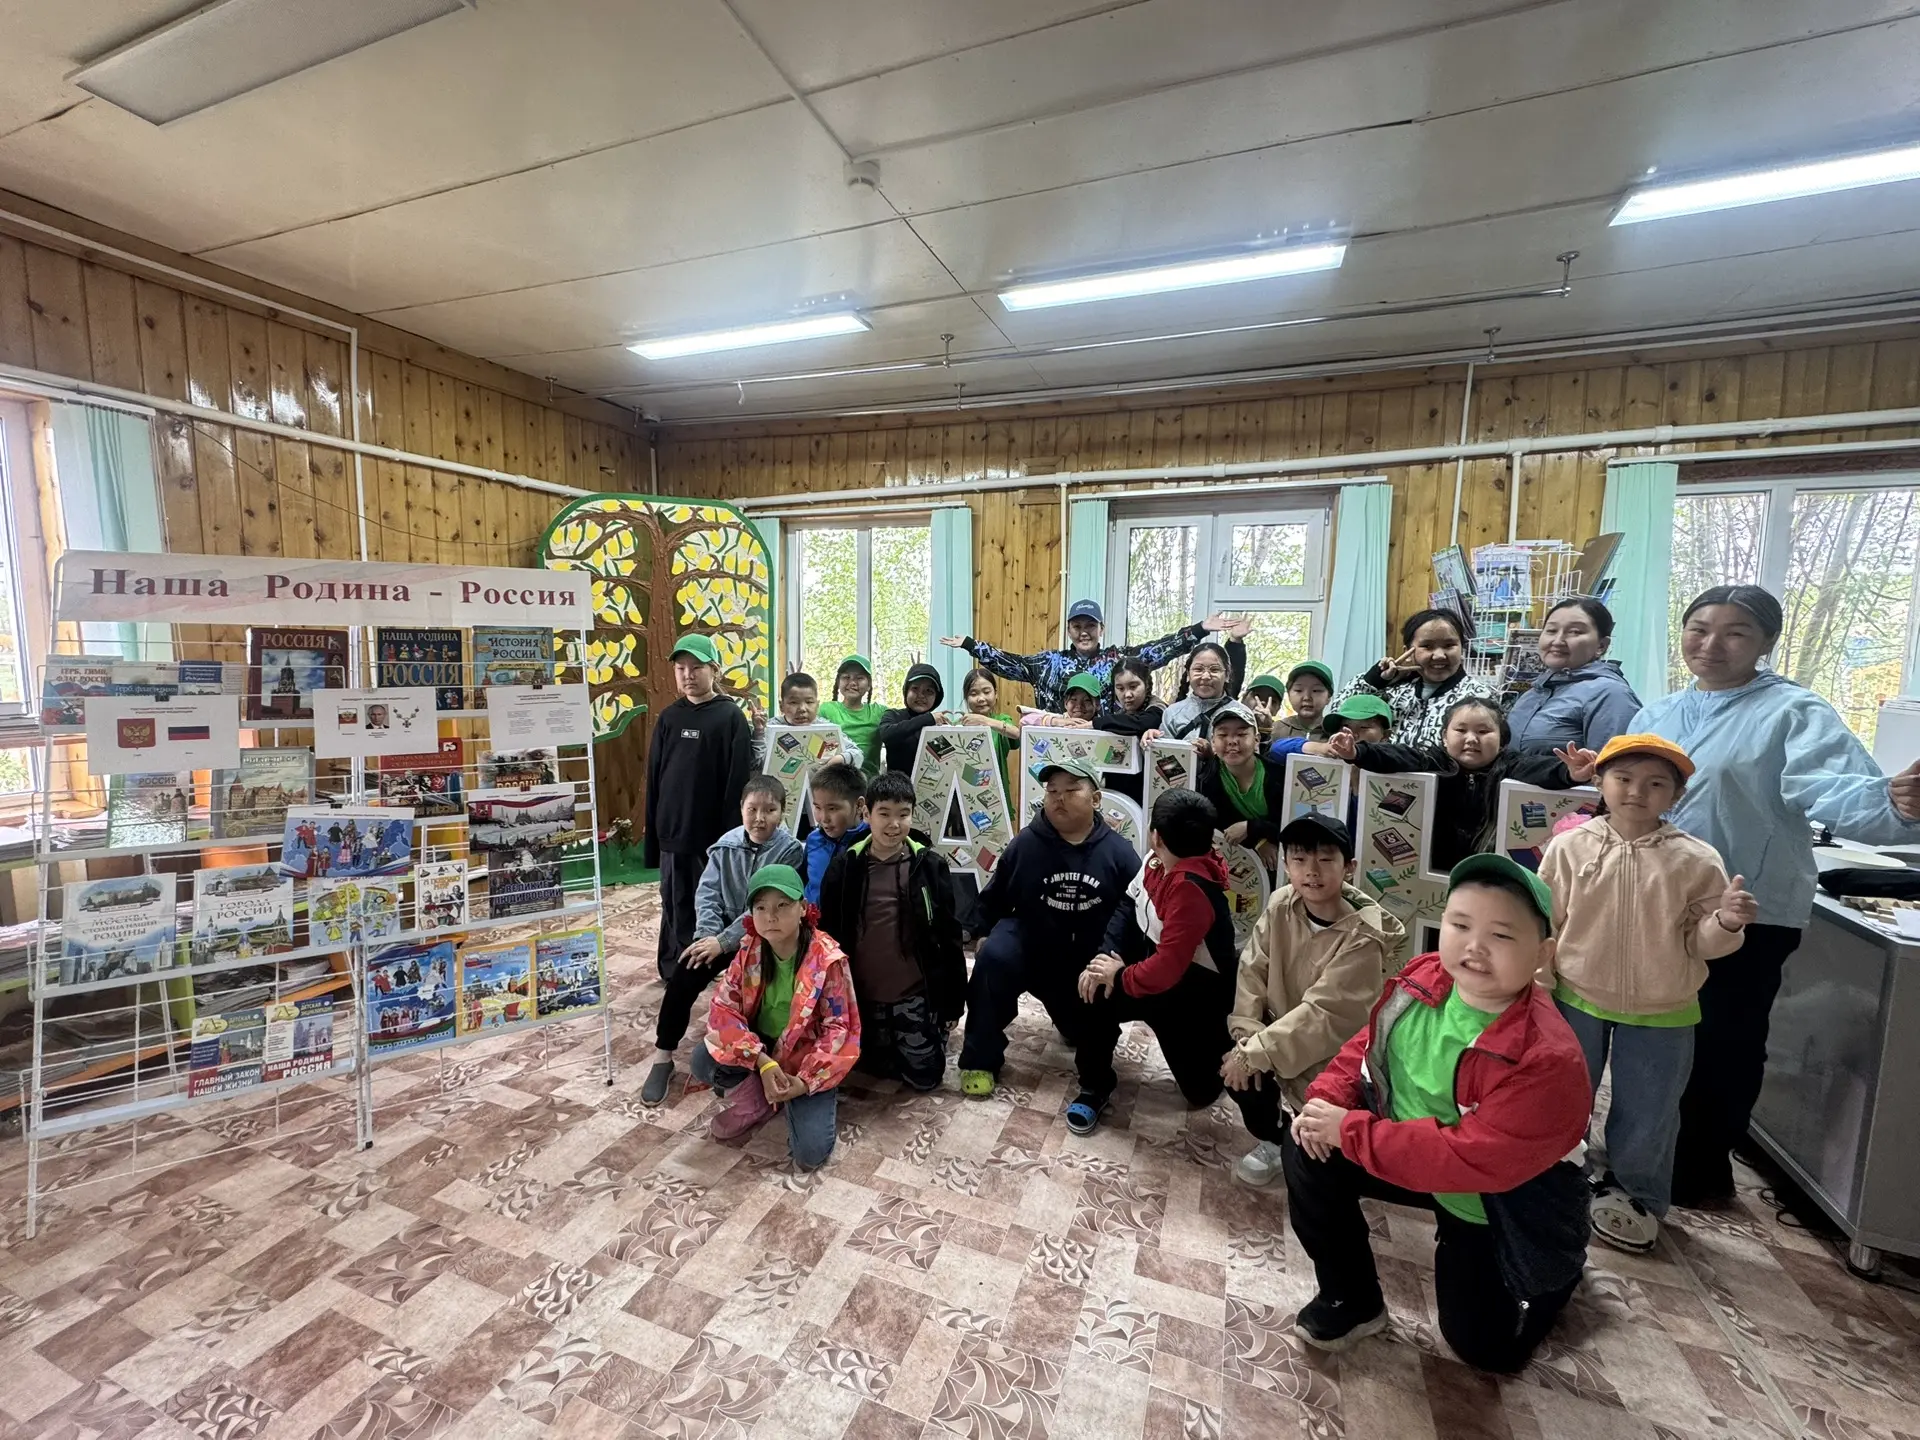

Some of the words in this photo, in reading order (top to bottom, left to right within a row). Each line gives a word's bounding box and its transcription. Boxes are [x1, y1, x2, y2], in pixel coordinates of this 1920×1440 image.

[89, 568, 230, 597] Наша
[263, 574, 411, 603] Родина
[459, 580, 576, 606] Россия
[261, 632, 326, 649] РОССИЯ
[382, 631, 414, 641] НАША
[417, 632, 459, 642] РОДИНА
[488, 637, 539, 648] ИСТОРИЯ
[493, 649, 537, 659] РОССИИ
[60, 667, 81, 676] ГЕРБ,
[380, 662, 461, 686] РОССИЯ
[138, 776, 177, 786] РОССИЯ
[505, 880, 550, 893] ВЕЛИКИЕ
[1082, 874, 1101, 889] MAN
[217, 906, 273, 919] РОССИИ
[94, 928, 146, 940] РОДИНЫ
[267, 1061, 291, 1072] НАША
[292, 1055, 325, 1067] РОДИНА
[282, 1061, 332, 1079] РОССИЯ
[193, 1073, 233, 1087] ГЛАВНЫЙ
[235, 1068, 260, 1080] ЗАКОН
[193, 1085, 222, 1097] НАШЕЙ
[224, 1079, 253, 1092] ЖИЗНИ
